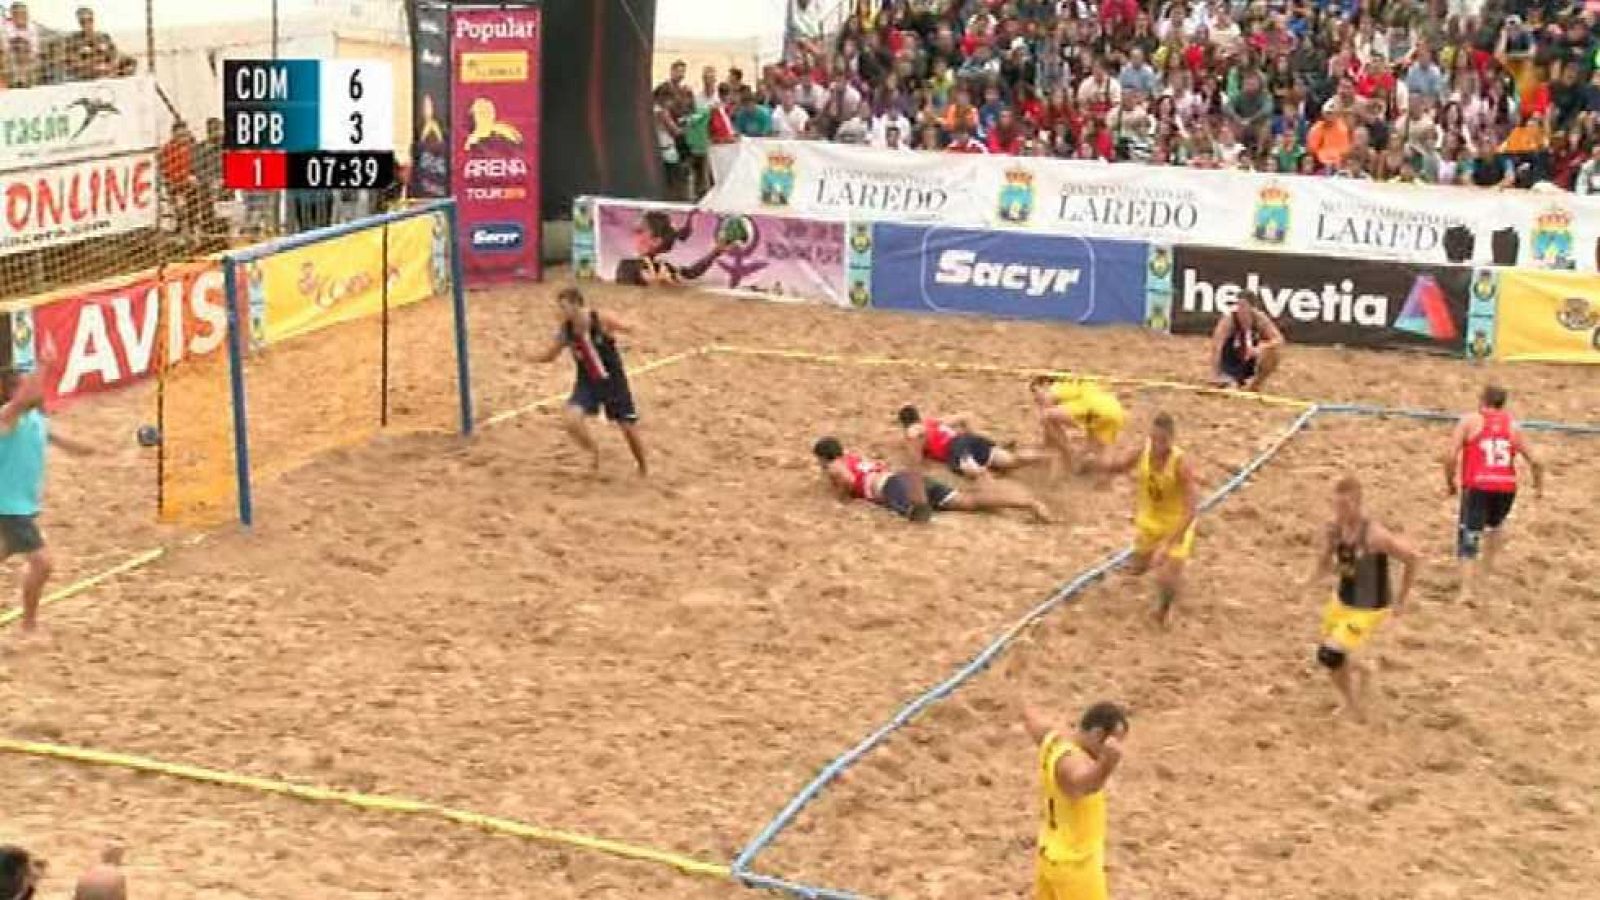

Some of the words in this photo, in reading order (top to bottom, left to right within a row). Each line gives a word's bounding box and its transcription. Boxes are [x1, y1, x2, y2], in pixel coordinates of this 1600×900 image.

[456, 17, 534, 43] Popular
[464, 158, 528, 178] ARENA
[6, 160, 152, 231] ONLINE
[816, 178, 948, 212] LAREDO
[1058, 195, 1198, 231] LAREDO
[1315, 213, 1441, 250] LARED
[935, 249, 1081, 297] Sacyr
[57, 271, 228, 395] AVIS
[1480, 438, 1511, 467] 15
